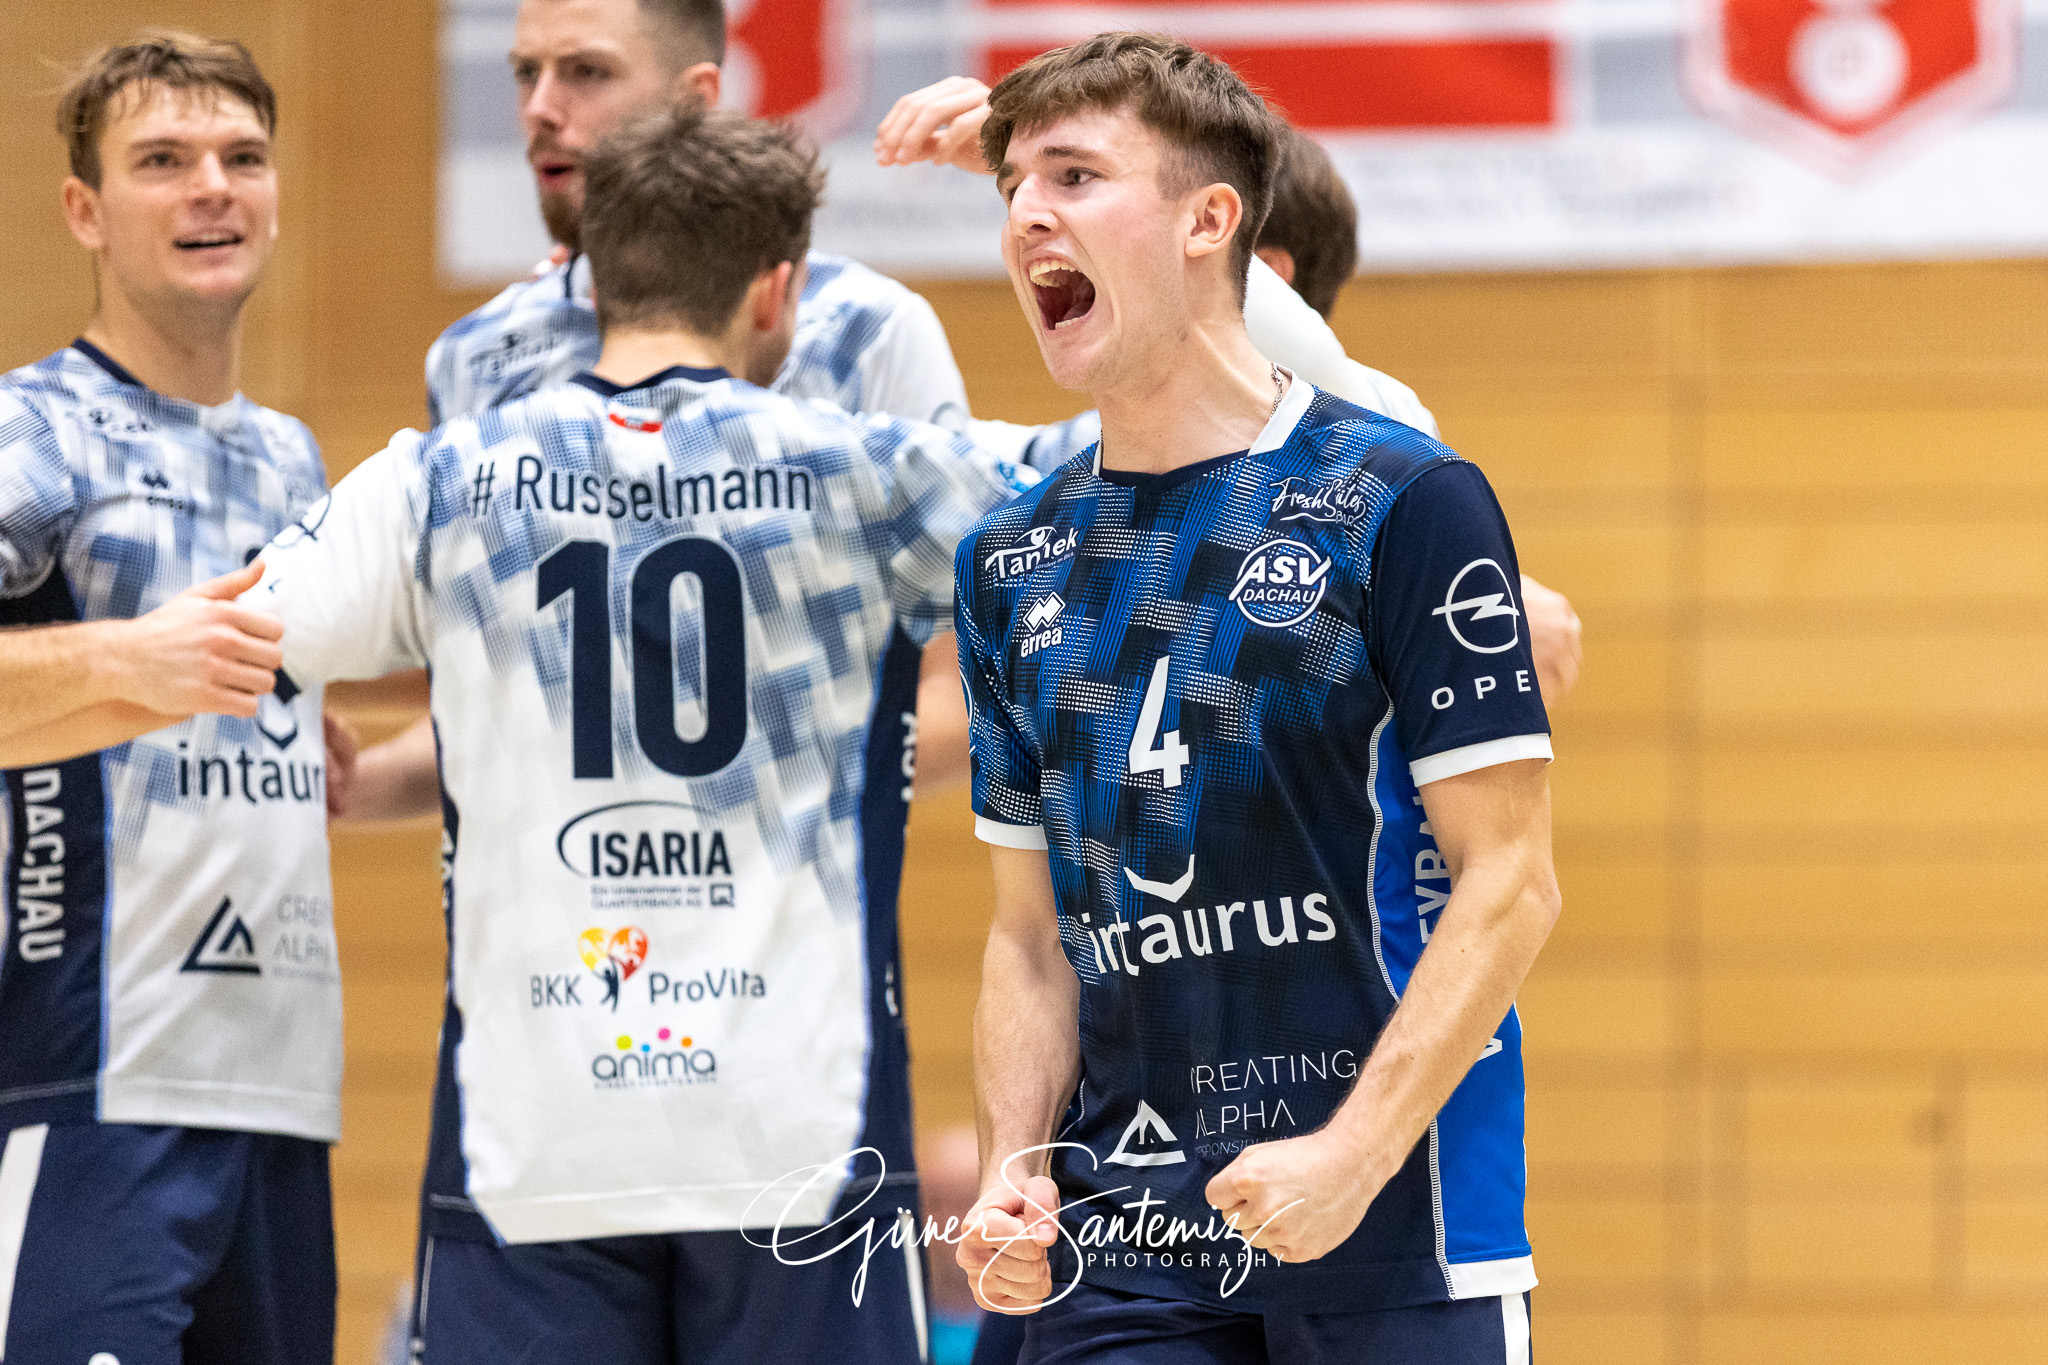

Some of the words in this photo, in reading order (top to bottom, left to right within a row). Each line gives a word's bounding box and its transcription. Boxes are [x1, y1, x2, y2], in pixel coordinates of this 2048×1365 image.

[472, 462, 496, 518] #
[515, 455, 813, 522] Russelmann
[1229, 556, 1331, 600] ASV
[1243, 589, 1316, 603] DACHAU
[536, 537, 748, 779] 10
[1128, 655, 1190, 790] 4
[17, 768, 66, 963] DACHAU
[590, 830, 732, 877] ISARIA
[1081, 893, 1337, 976] intaurus
[530, 974, 582, 1008] BKK
[649, 967, 767, 1004] ProVita
[592, 1046, 716, 1080] anima
